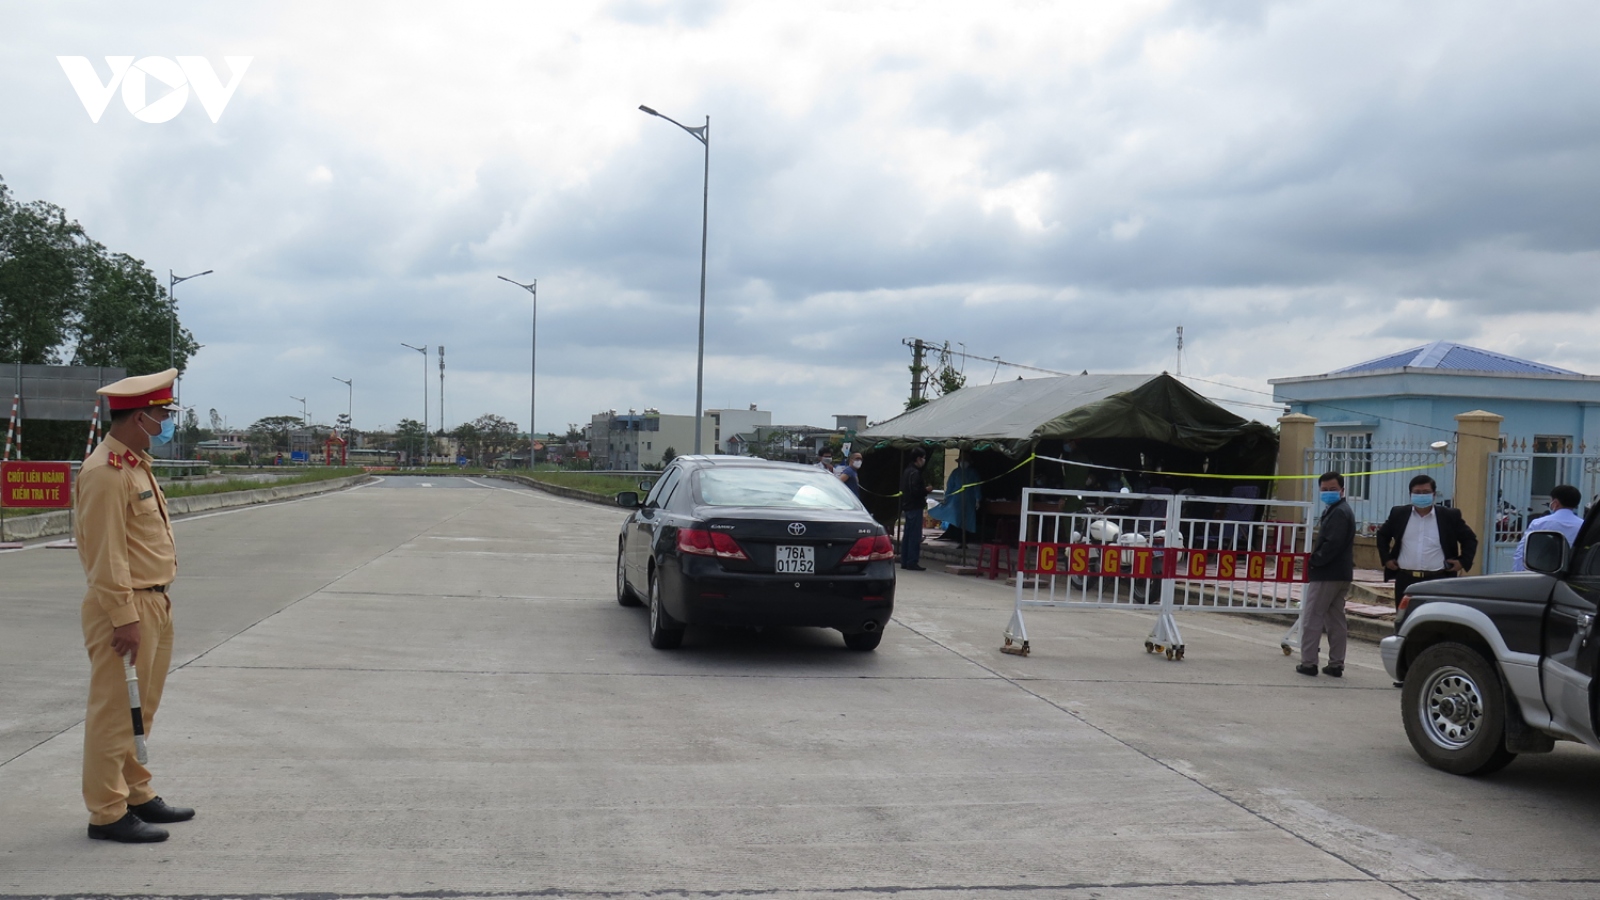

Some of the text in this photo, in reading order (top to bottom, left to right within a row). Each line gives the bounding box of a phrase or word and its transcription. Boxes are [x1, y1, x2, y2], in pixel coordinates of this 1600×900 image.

[7, 467, 24, 483] CHỐT
[26, 469, 40, 483] LIÊN
[12, 484, 60, 500] KIỂM TRA Y TẾ
[785, 547, 805, 559] 76A
[777, 560, 814, 573] 017.52
